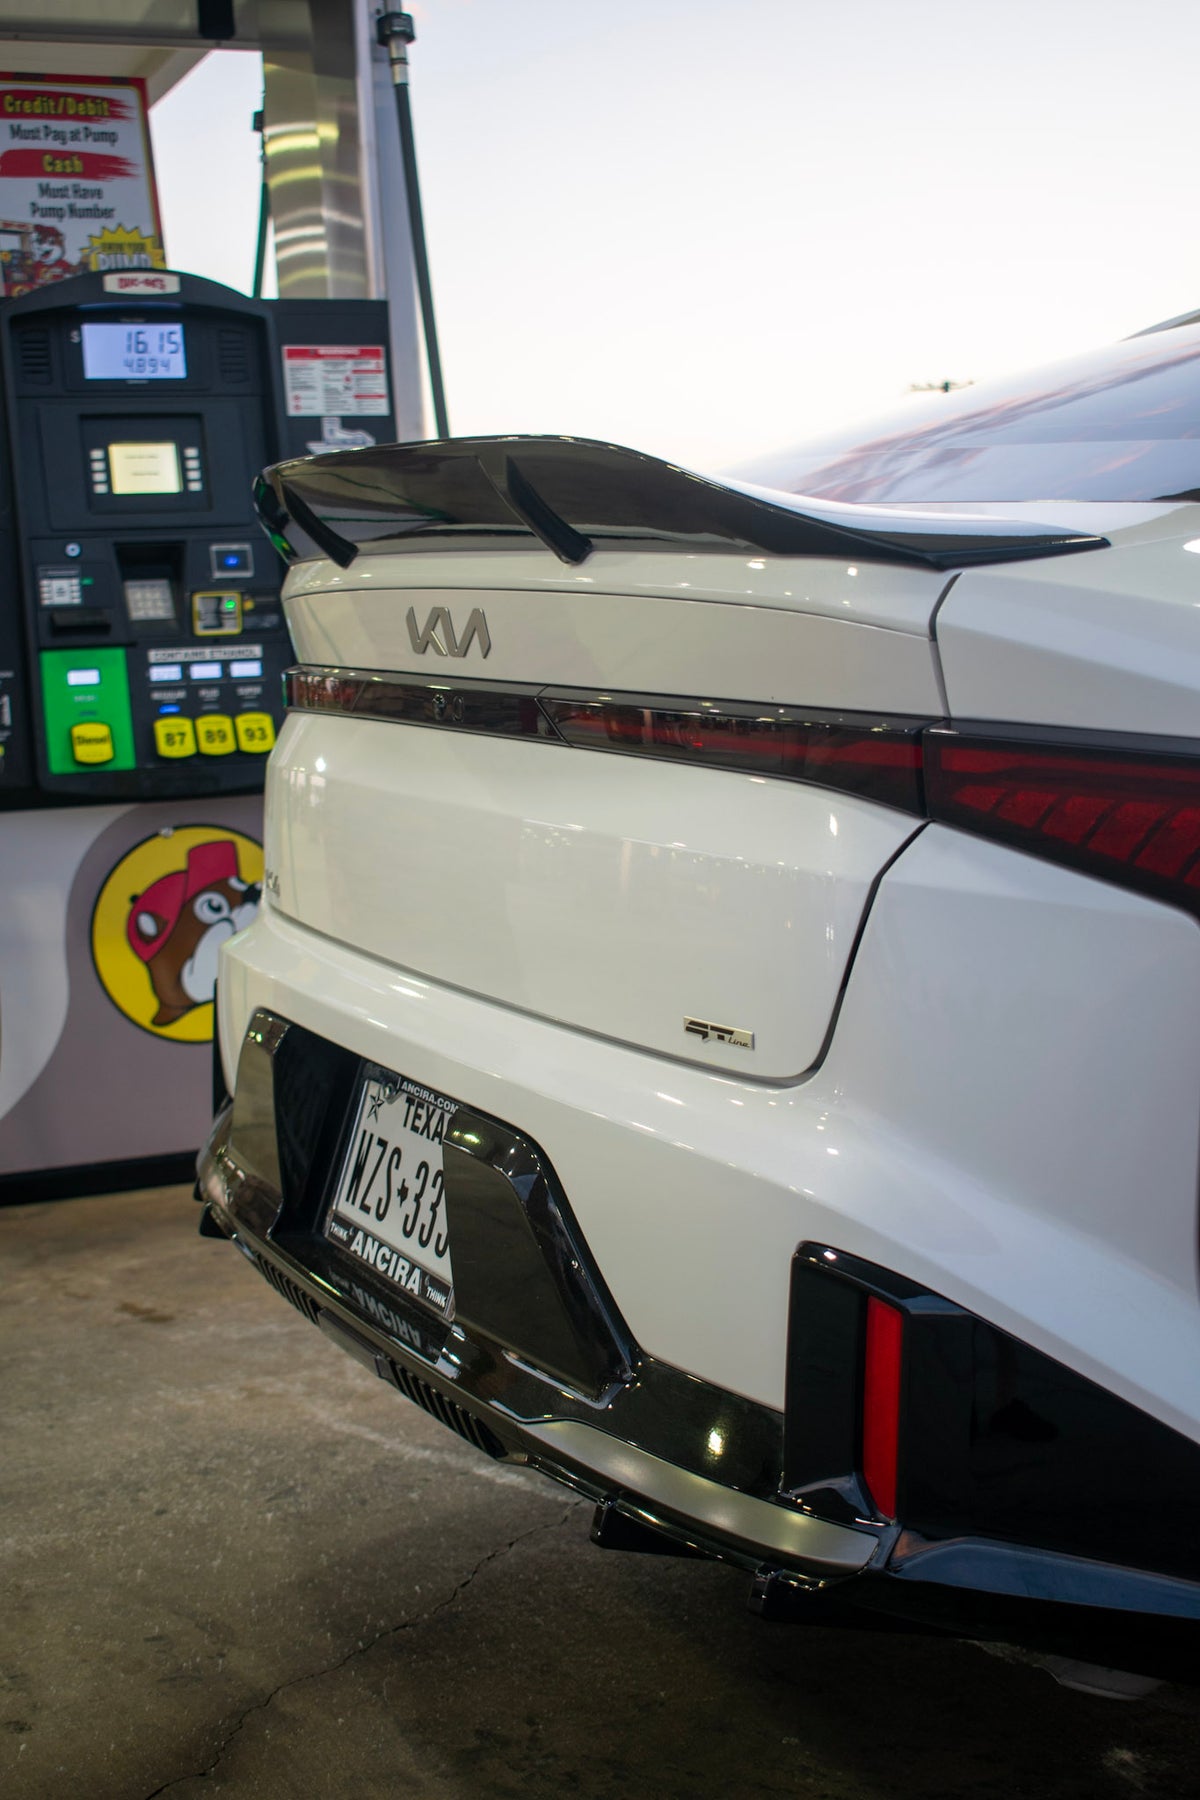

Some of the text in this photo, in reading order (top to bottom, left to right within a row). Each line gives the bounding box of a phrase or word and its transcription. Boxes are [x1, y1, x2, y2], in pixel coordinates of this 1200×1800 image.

[4, 94, 110, 117] Credit/Debit
[10, 124, 118, 146] Must Pay at Pump
[43, 154, 84, 173] Cash
[38, 183, 103, 199] Must Have
[30, 202, 115, 221] Pump Number
[406, 606, 492, 659] KIA
[76, 734, 110, 746] Diesel
[165, 732, 187, 747] 87
[205, 729, 228, 743] 89
[245, 727, 268, 742] 93
[403, 1095, 446, 1146] TEXA
[349, 1230, 422, 1296] ANCIRA
[426, 1286, 448, 1308] THINK
